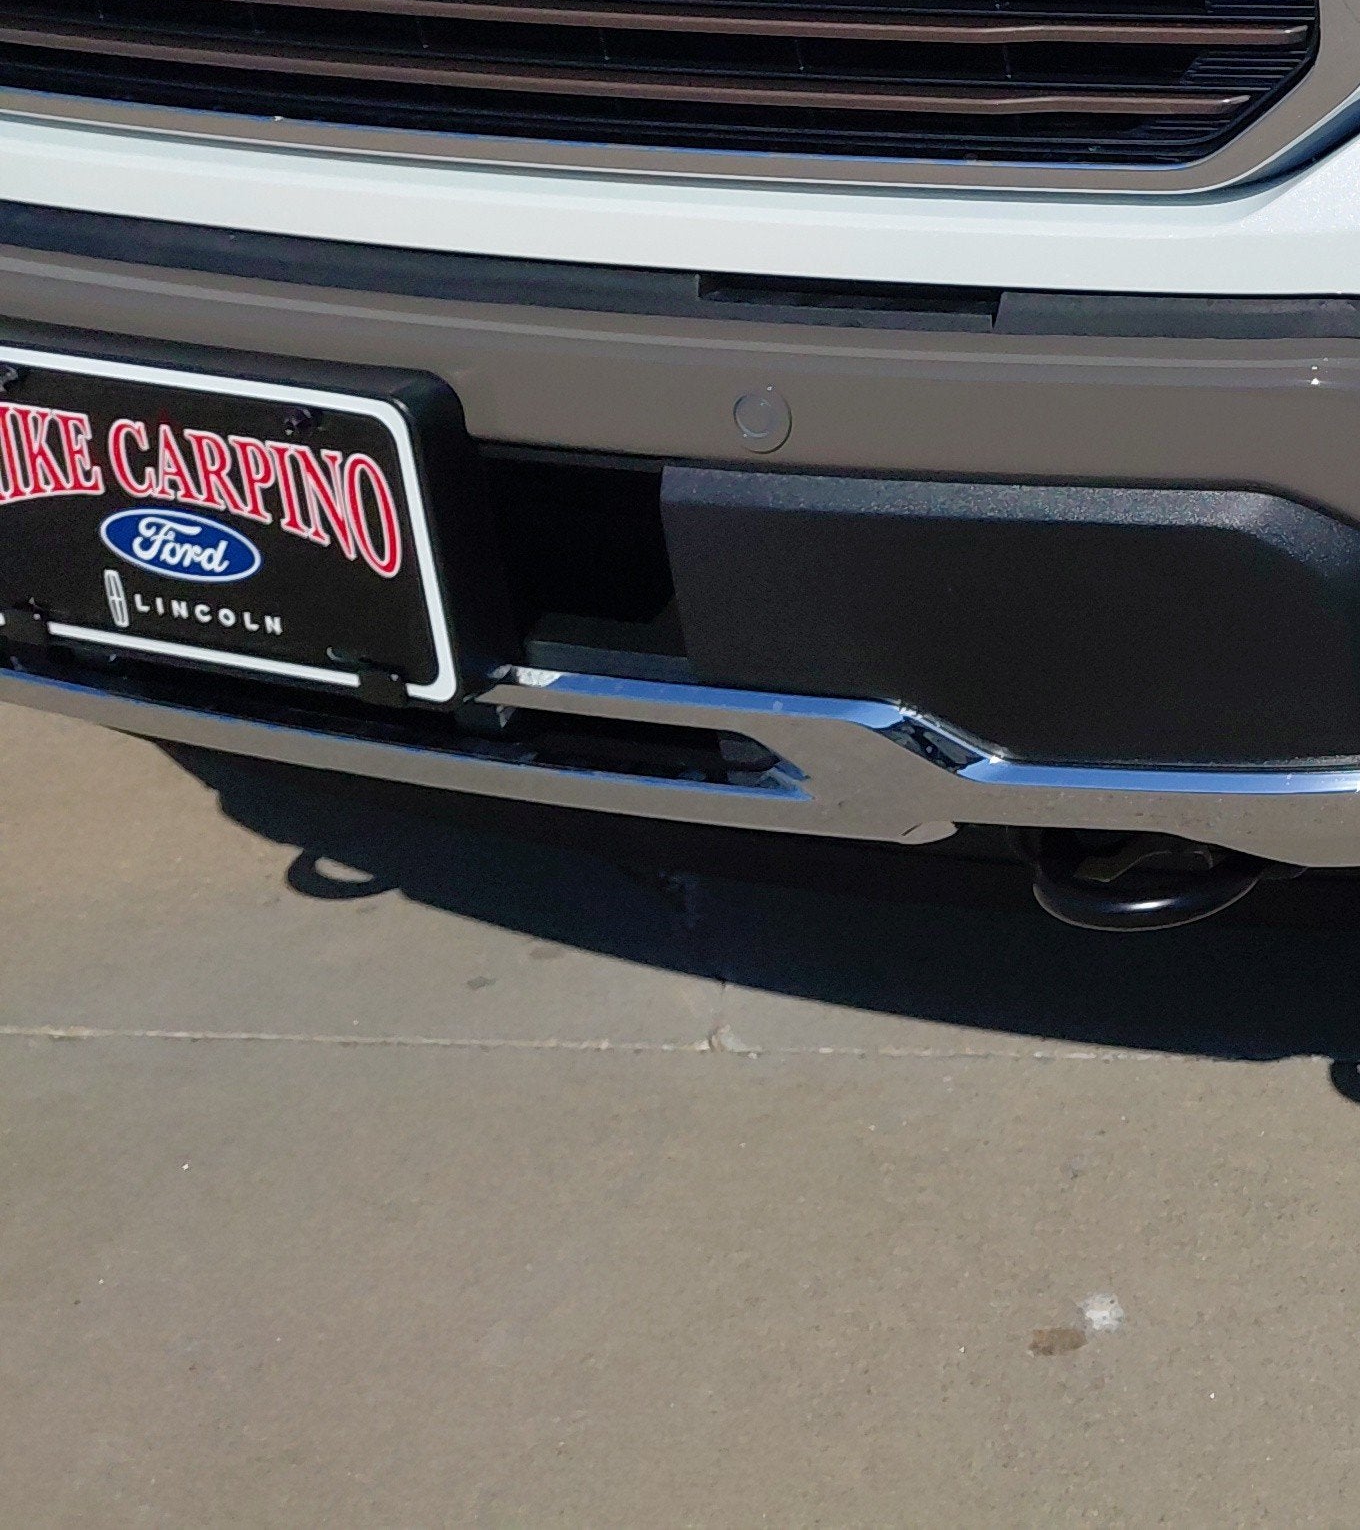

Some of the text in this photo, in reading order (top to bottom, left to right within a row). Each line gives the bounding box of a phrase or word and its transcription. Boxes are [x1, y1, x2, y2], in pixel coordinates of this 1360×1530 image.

[0, 400, 403, 579] IKE CARPINO
[131, 515, 230, 573] Ford
[133, 592, 284, 636] LINCOLN
